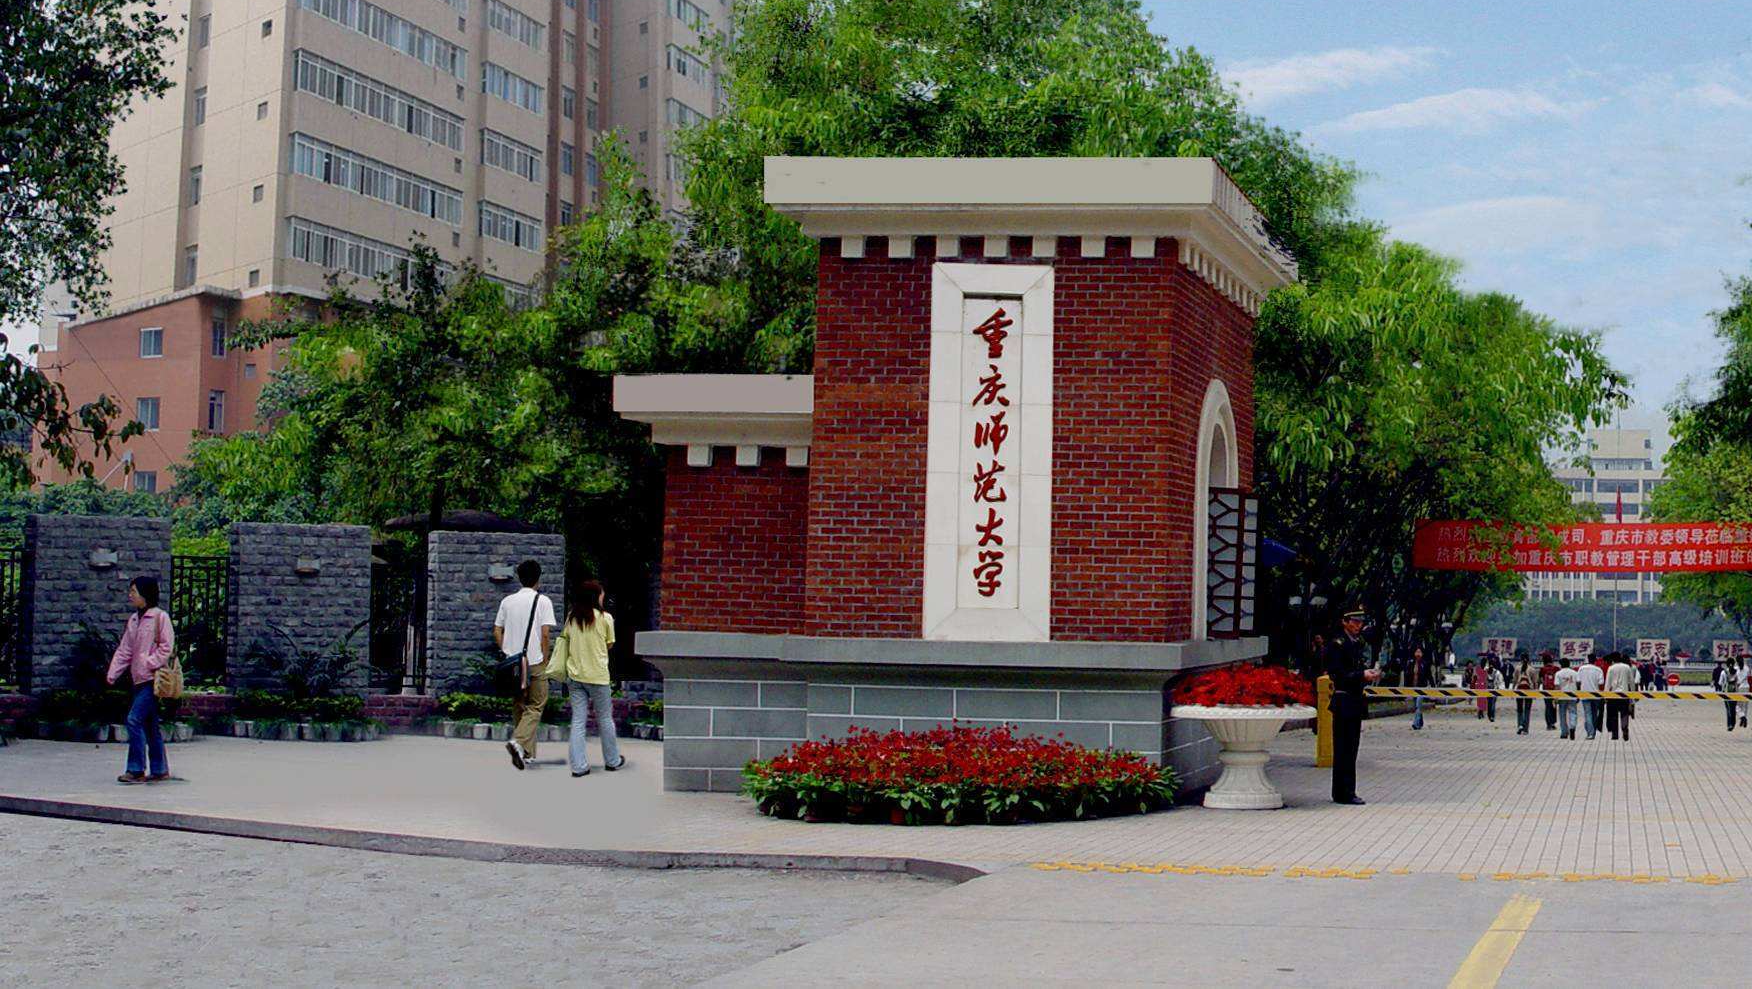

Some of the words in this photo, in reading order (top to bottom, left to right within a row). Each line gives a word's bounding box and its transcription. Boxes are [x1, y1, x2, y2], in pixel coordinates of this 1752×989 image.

[973, 307, 1014, 598] 重庆师范大学
